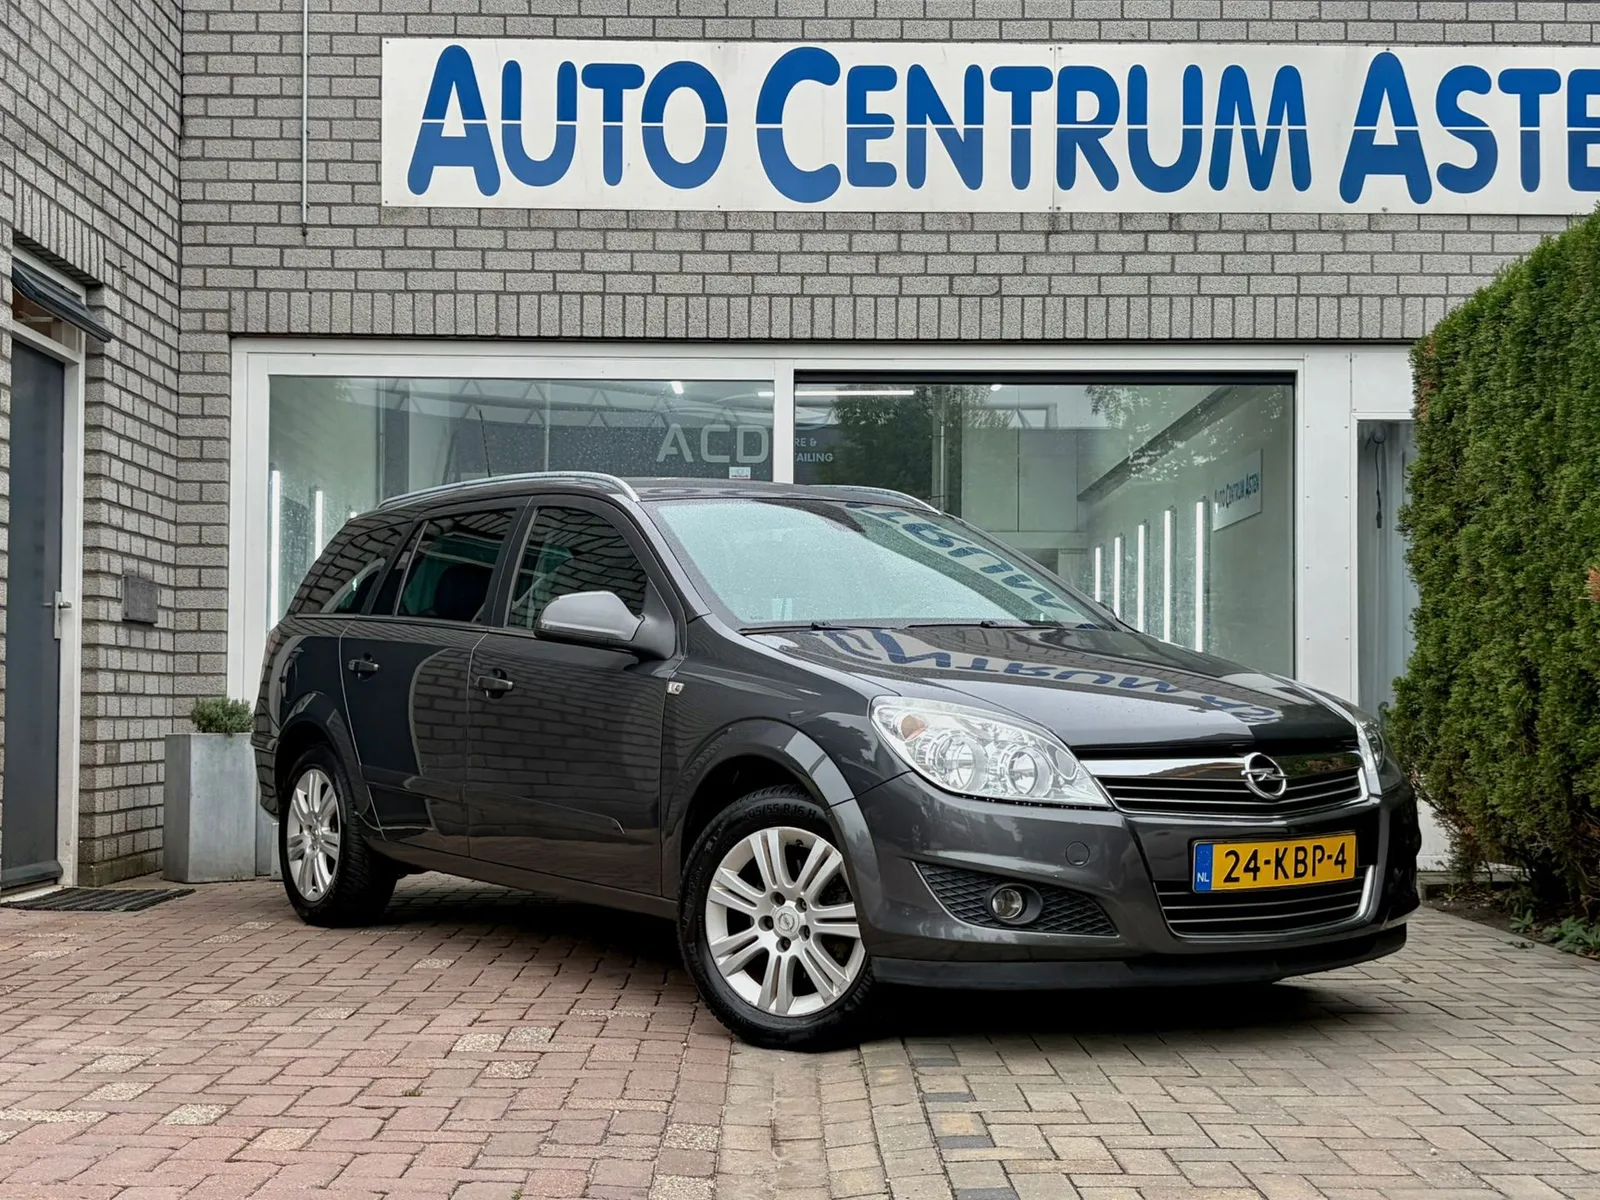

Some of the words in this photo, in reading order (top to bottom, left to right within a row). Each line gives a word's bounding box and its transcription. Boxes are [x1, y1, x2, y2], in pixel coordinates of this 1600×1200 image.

[407, 44, 728, 196] AUTO
[756, 46, 1312, 204] CENTRUM
[1339, 51, 1600, 205] ASTE
[656, 423, 769, 463] ACD
[795, 437, 806, 447] RE
[795, 452, 833, 463] AILING
[1222, 841, 1347, 883] 24-KBP-4
[1196, 872, 1210, 883] NL
